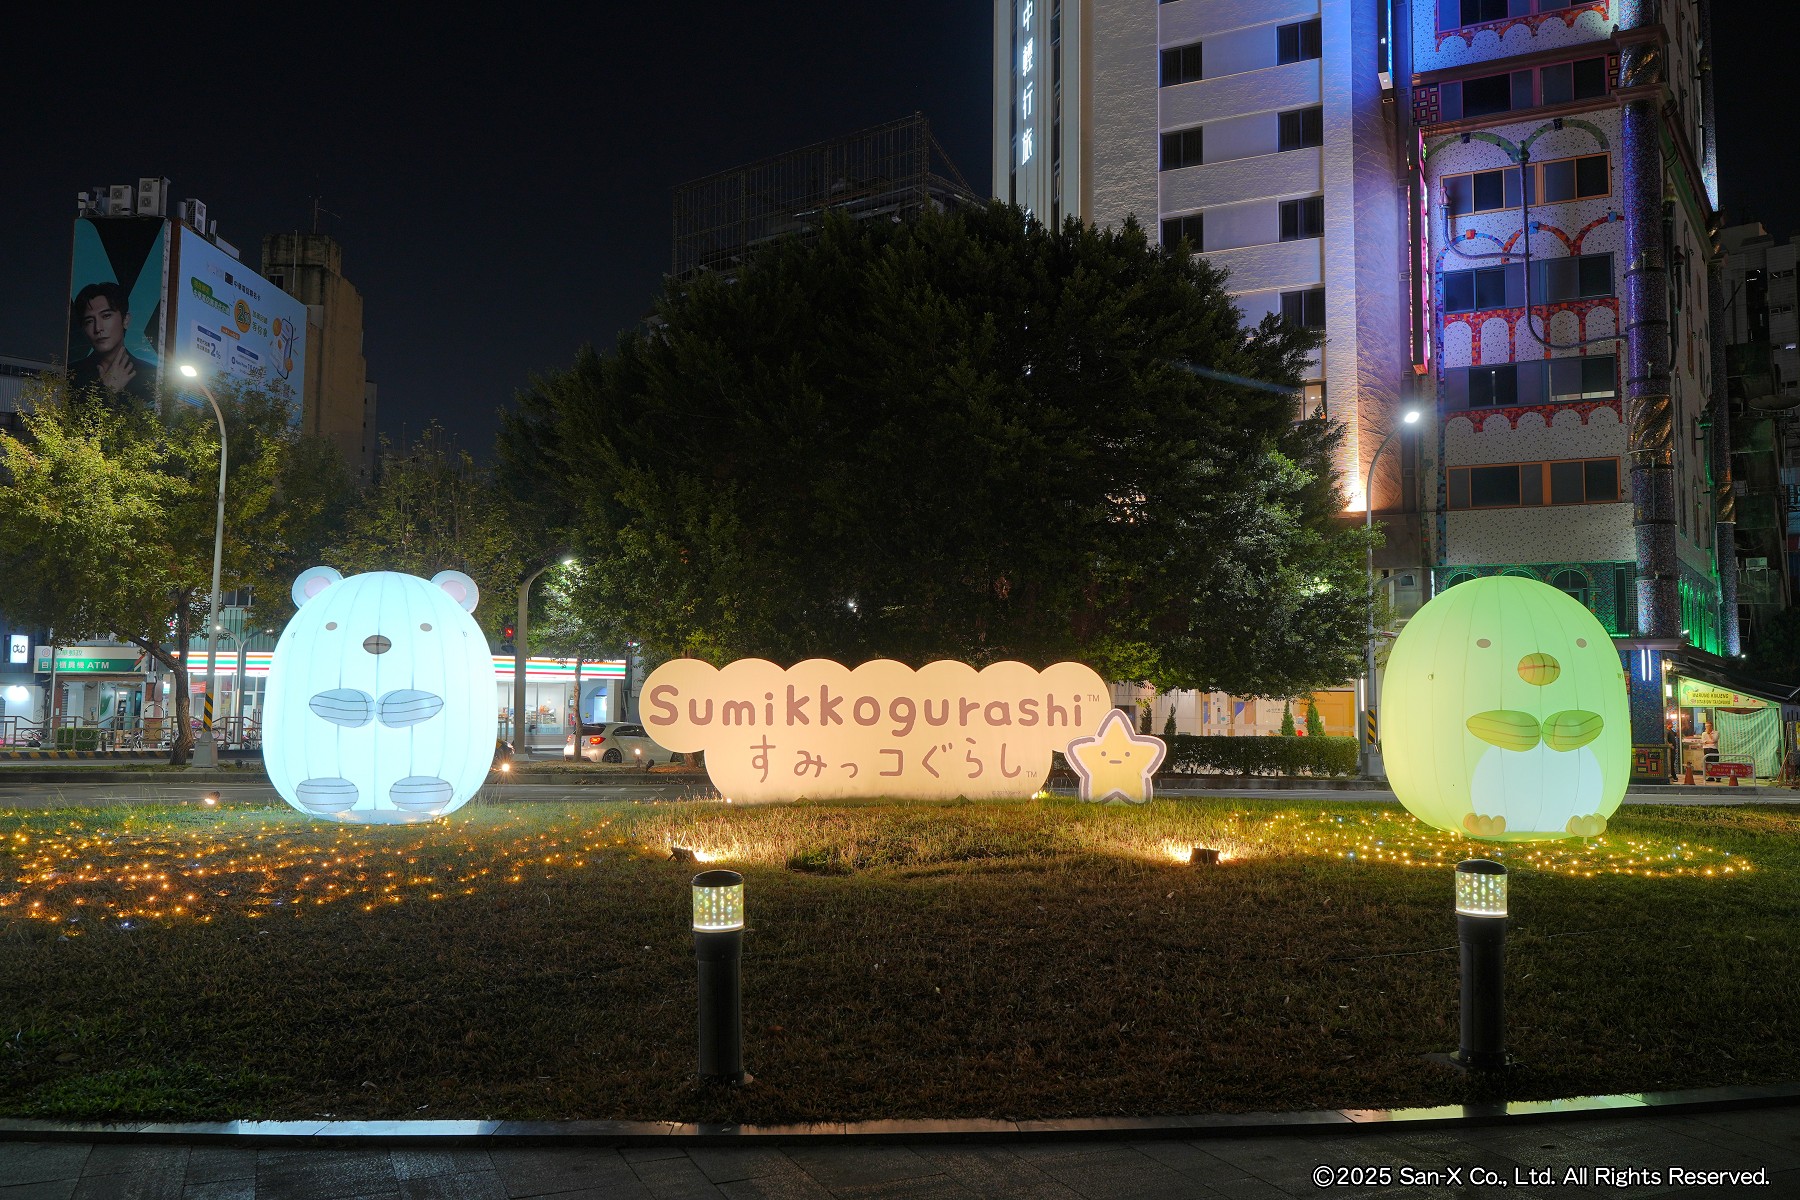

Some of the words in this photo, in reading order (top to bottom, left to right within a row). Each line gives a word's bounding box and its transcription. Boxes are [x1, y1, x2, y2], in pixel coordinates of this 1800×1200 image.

[87, 661, 110, 669] ATM
[649, 684, 1082, 737] Sumikkogurashi
[750, 735, 1022, 783] すみっコぐらし
